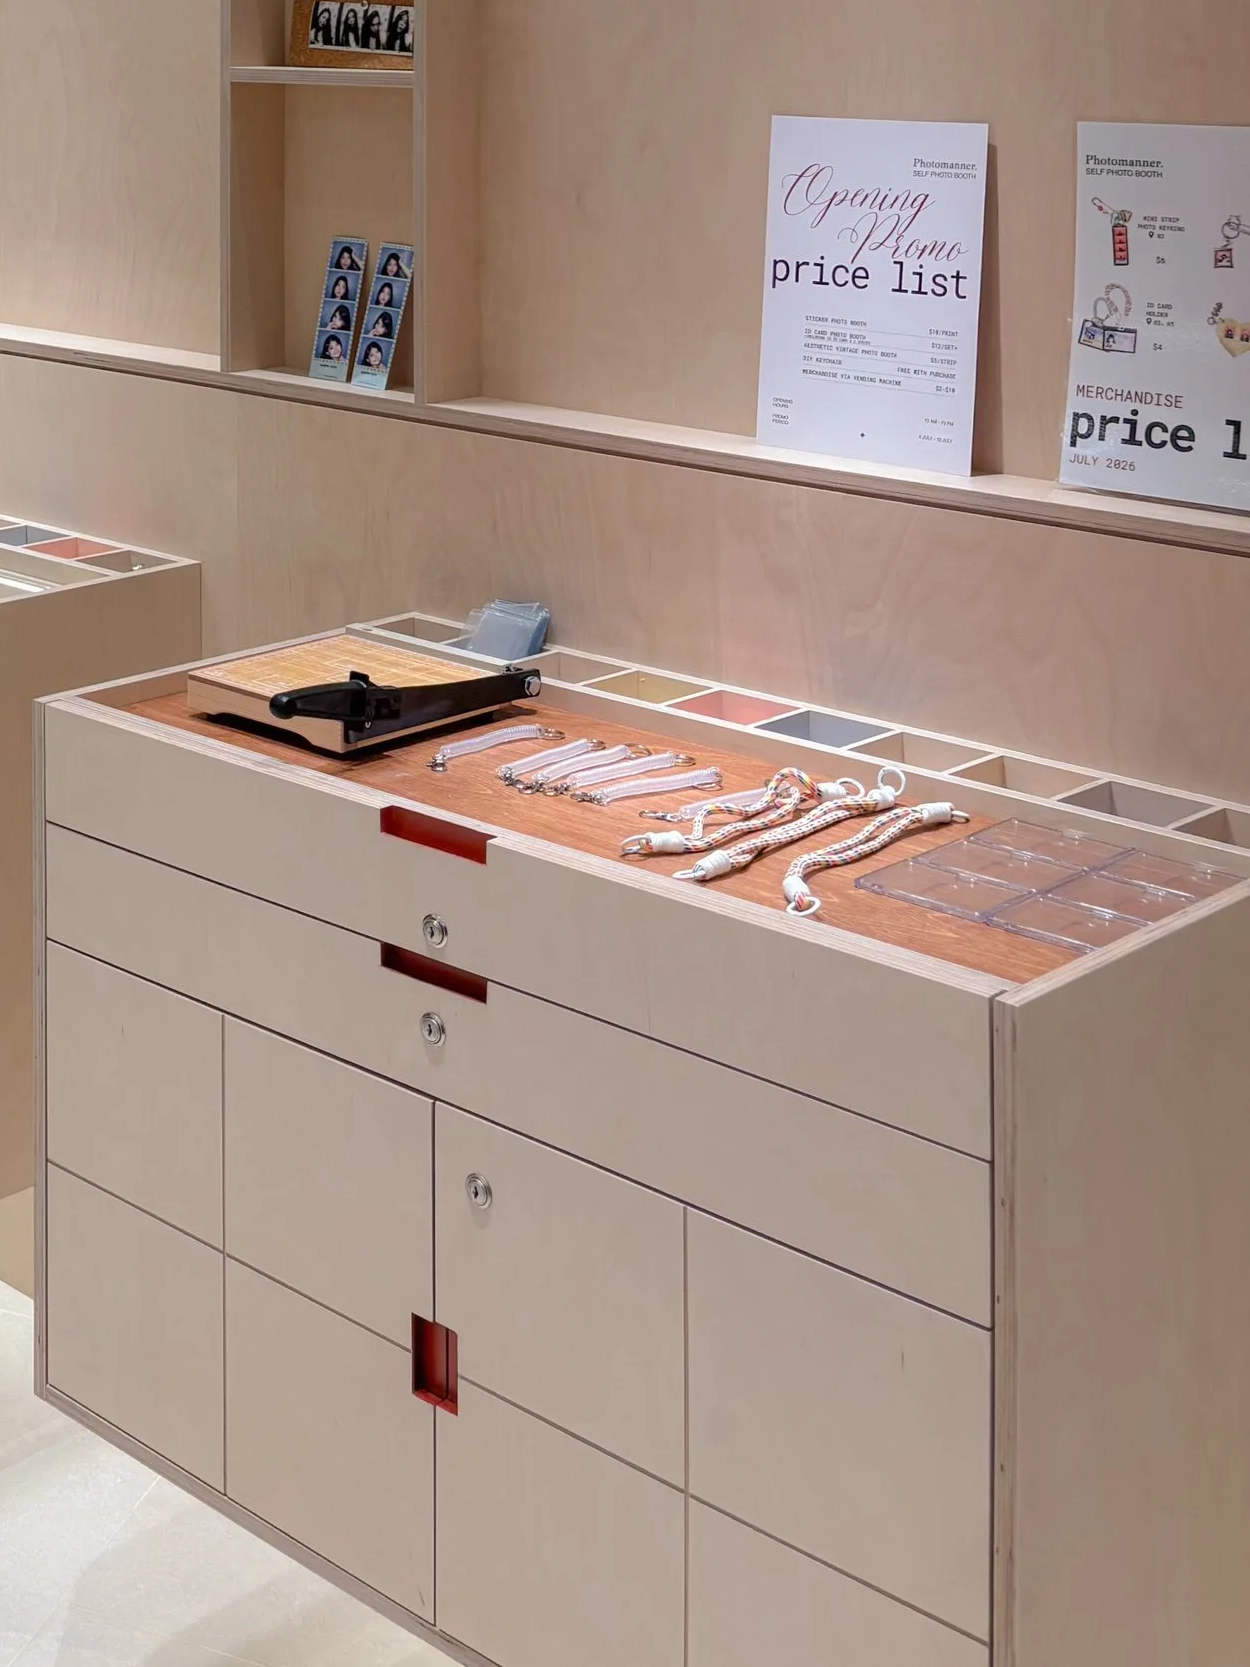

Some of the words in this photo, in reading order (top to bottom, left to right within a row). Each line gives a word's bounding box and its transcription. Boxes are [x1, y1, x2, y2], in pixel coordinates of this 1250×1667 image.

[913, 158, 977, 170] Photomanner.
[1086, 154, 1164, 168] Photomanner.
[1106, 169, 1133, 177] PHOTO
[1135, 170, 1163, 178] BOOTH
[782, 164, 936, 235] Opening
[837, 212, 969, 264] Promo
[772, 256, 869, 289] price
[891, 260, 967, 299] list
[831, 317, 847, 325] PHOTO
[850, 319, 867, 327] BOOTH
[802, 369, 837, 378] MERCHANDISE
[854, 375, 876, 383] VENDING
[929, 370, 956, 380] PURCHASE
[1076, 384, 1183, 409] MERCHANDISE
[1070, 409, 1195, 452] price
[1223, 419, 1247, 460] l
[1069, 454, 1099, 466] JULY
[1106, 458, 1136, 471] 2026
